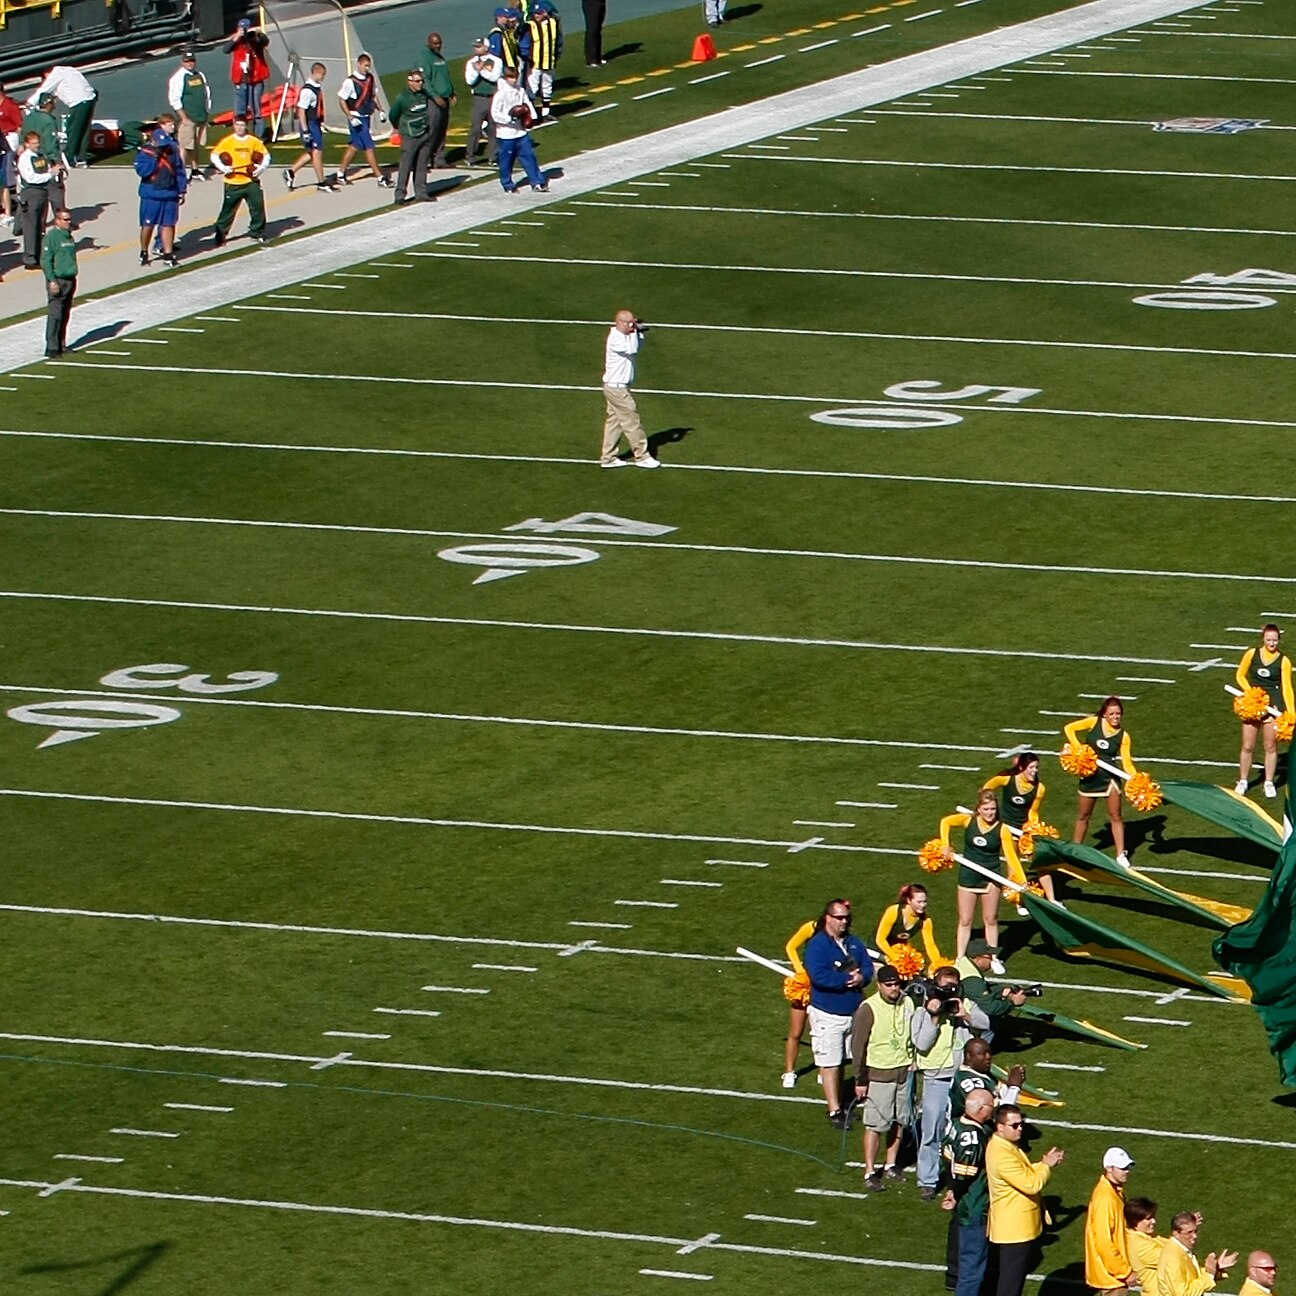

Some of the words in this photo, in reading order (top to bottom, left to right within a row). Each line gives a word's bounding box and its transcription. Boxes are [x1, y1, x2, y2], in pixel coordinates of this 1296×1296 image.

[810, 380, 1042, 428] 50
[437, 512, 679, 571] 40
[6, 663, 279, 729] 30
[960, 1077, 985, 1093] 93
[960, 1130, 979, 1145] 31
